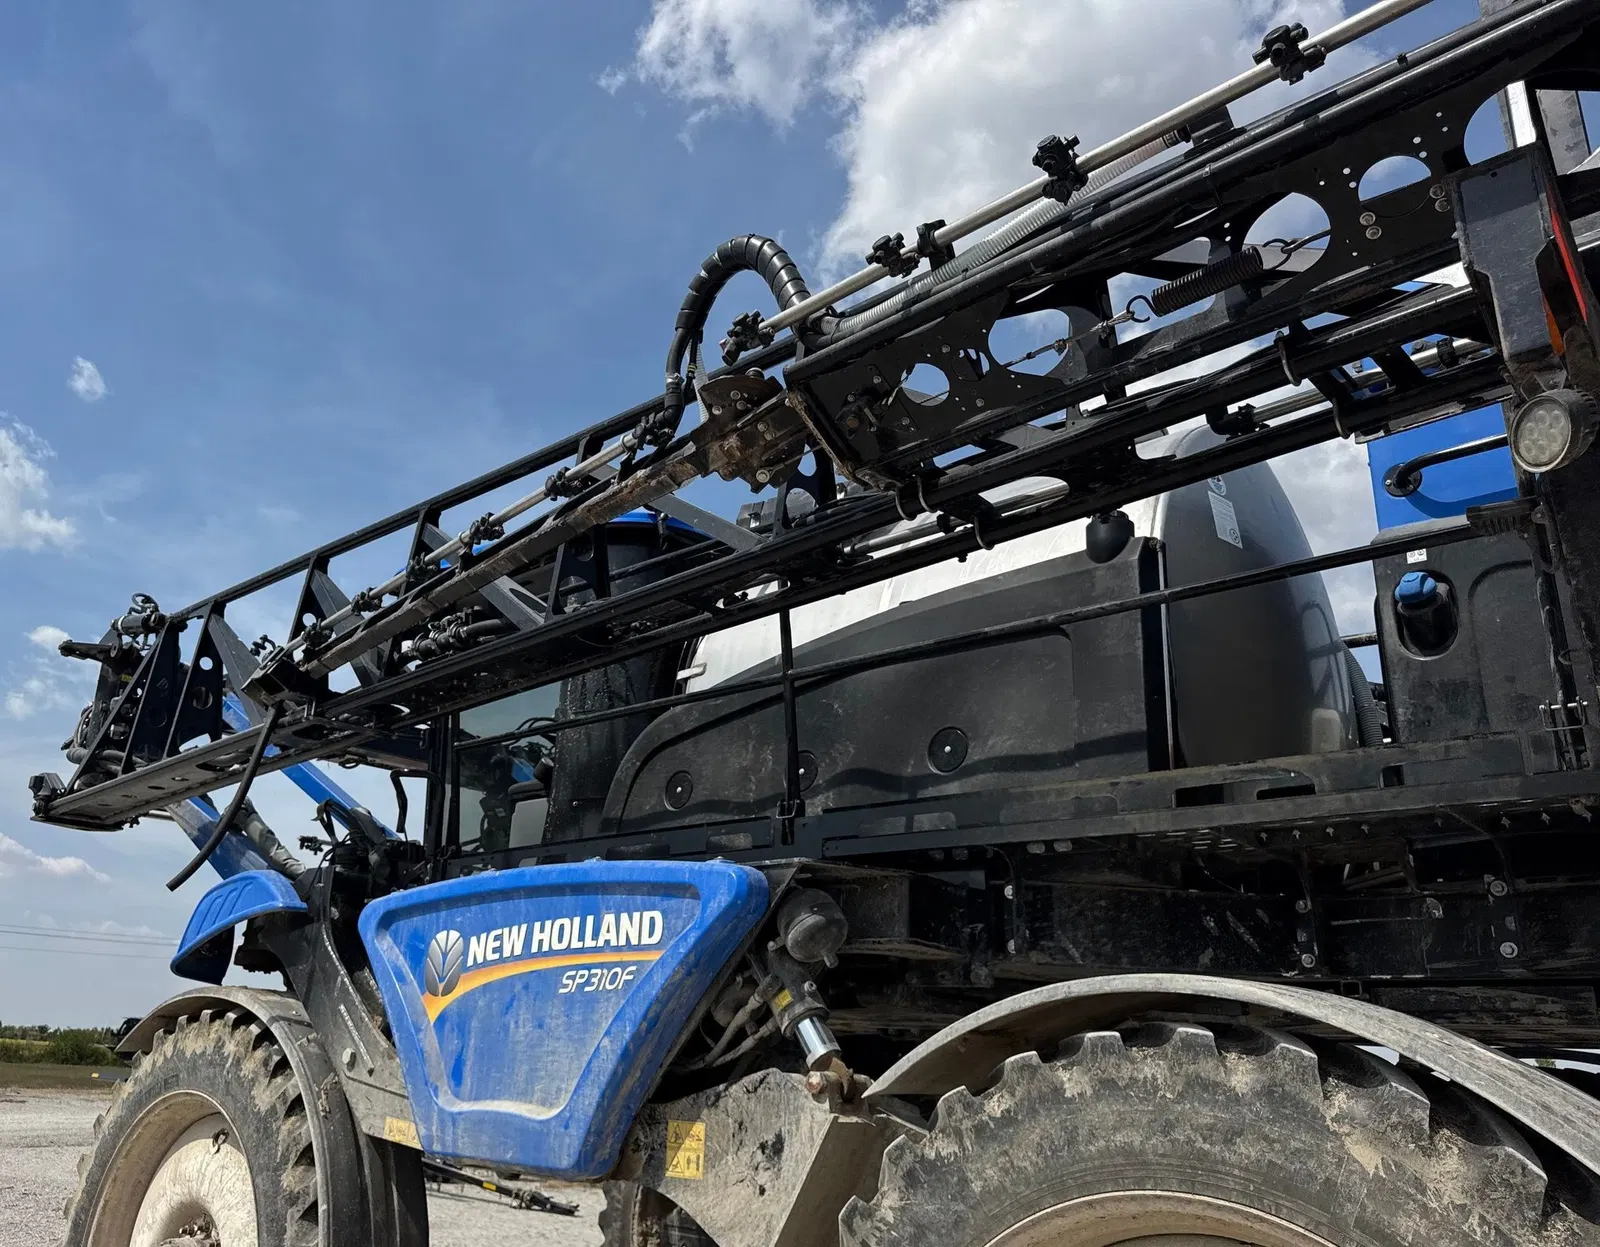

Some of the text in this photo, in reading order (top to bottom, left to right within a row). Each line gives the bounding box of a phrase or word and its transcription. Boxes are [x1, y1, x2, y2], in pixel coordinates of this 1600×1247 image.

[467, 910, 663, 967] NEW HOLLAND
[558, 966, 637, 994] SP310F
